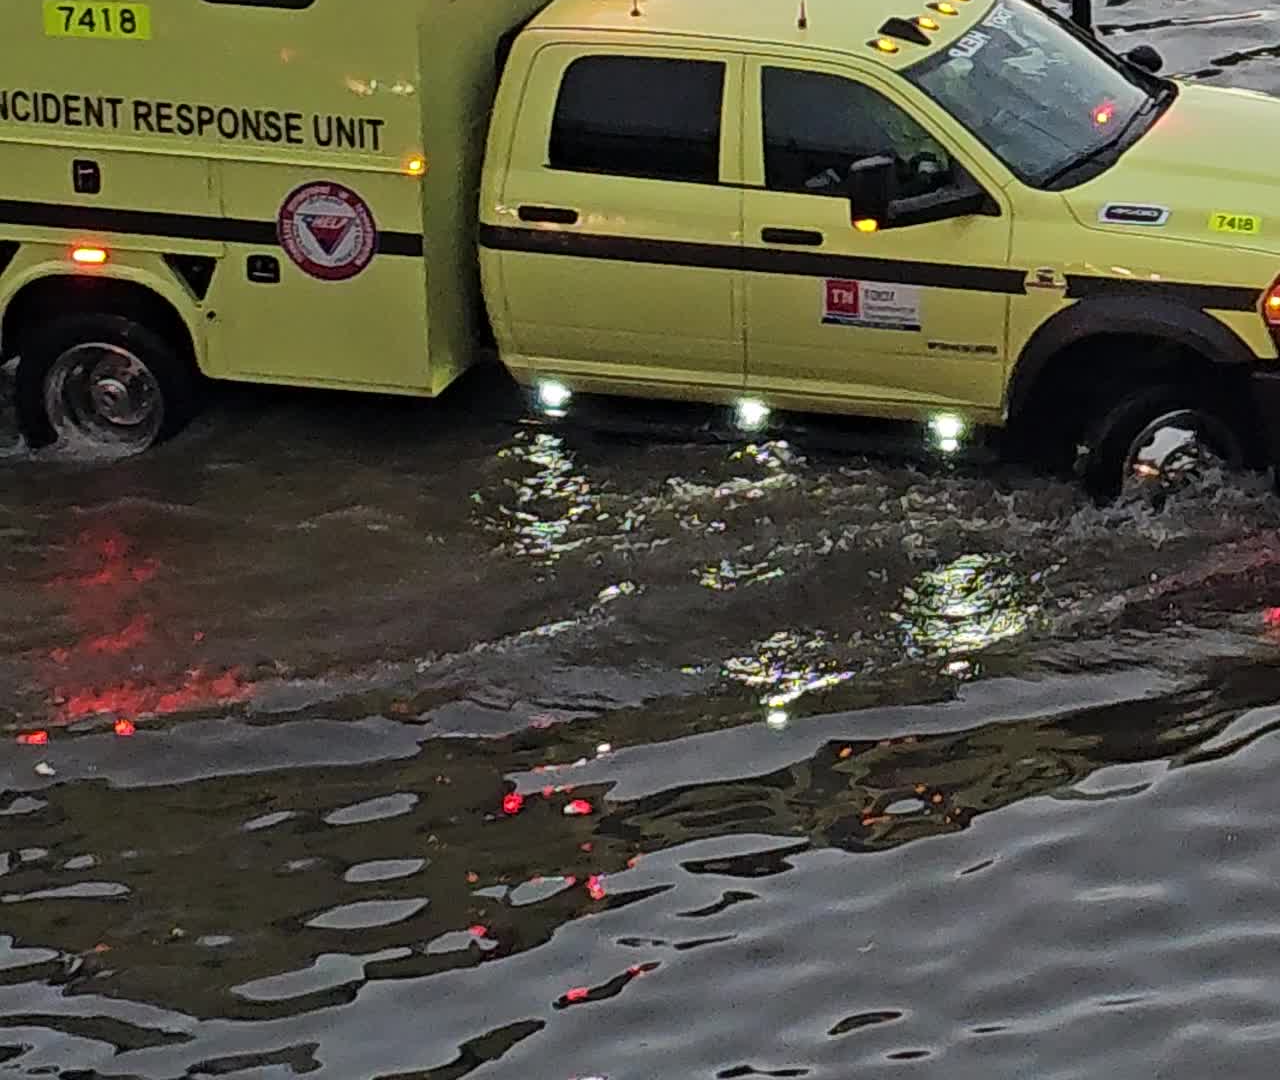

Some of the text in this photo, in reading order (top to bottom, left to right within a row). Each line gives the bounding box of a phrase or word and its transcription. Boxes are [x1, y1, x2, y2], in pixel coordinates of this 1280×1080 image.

[57, 6, 136, 34] 7418
[133, 100, 304, 144] RESPONSE
[313, 115, 385, 150] UNIT
[1216, 216, 1254, 231] 7418
[831, 288, 854, 304] TN
